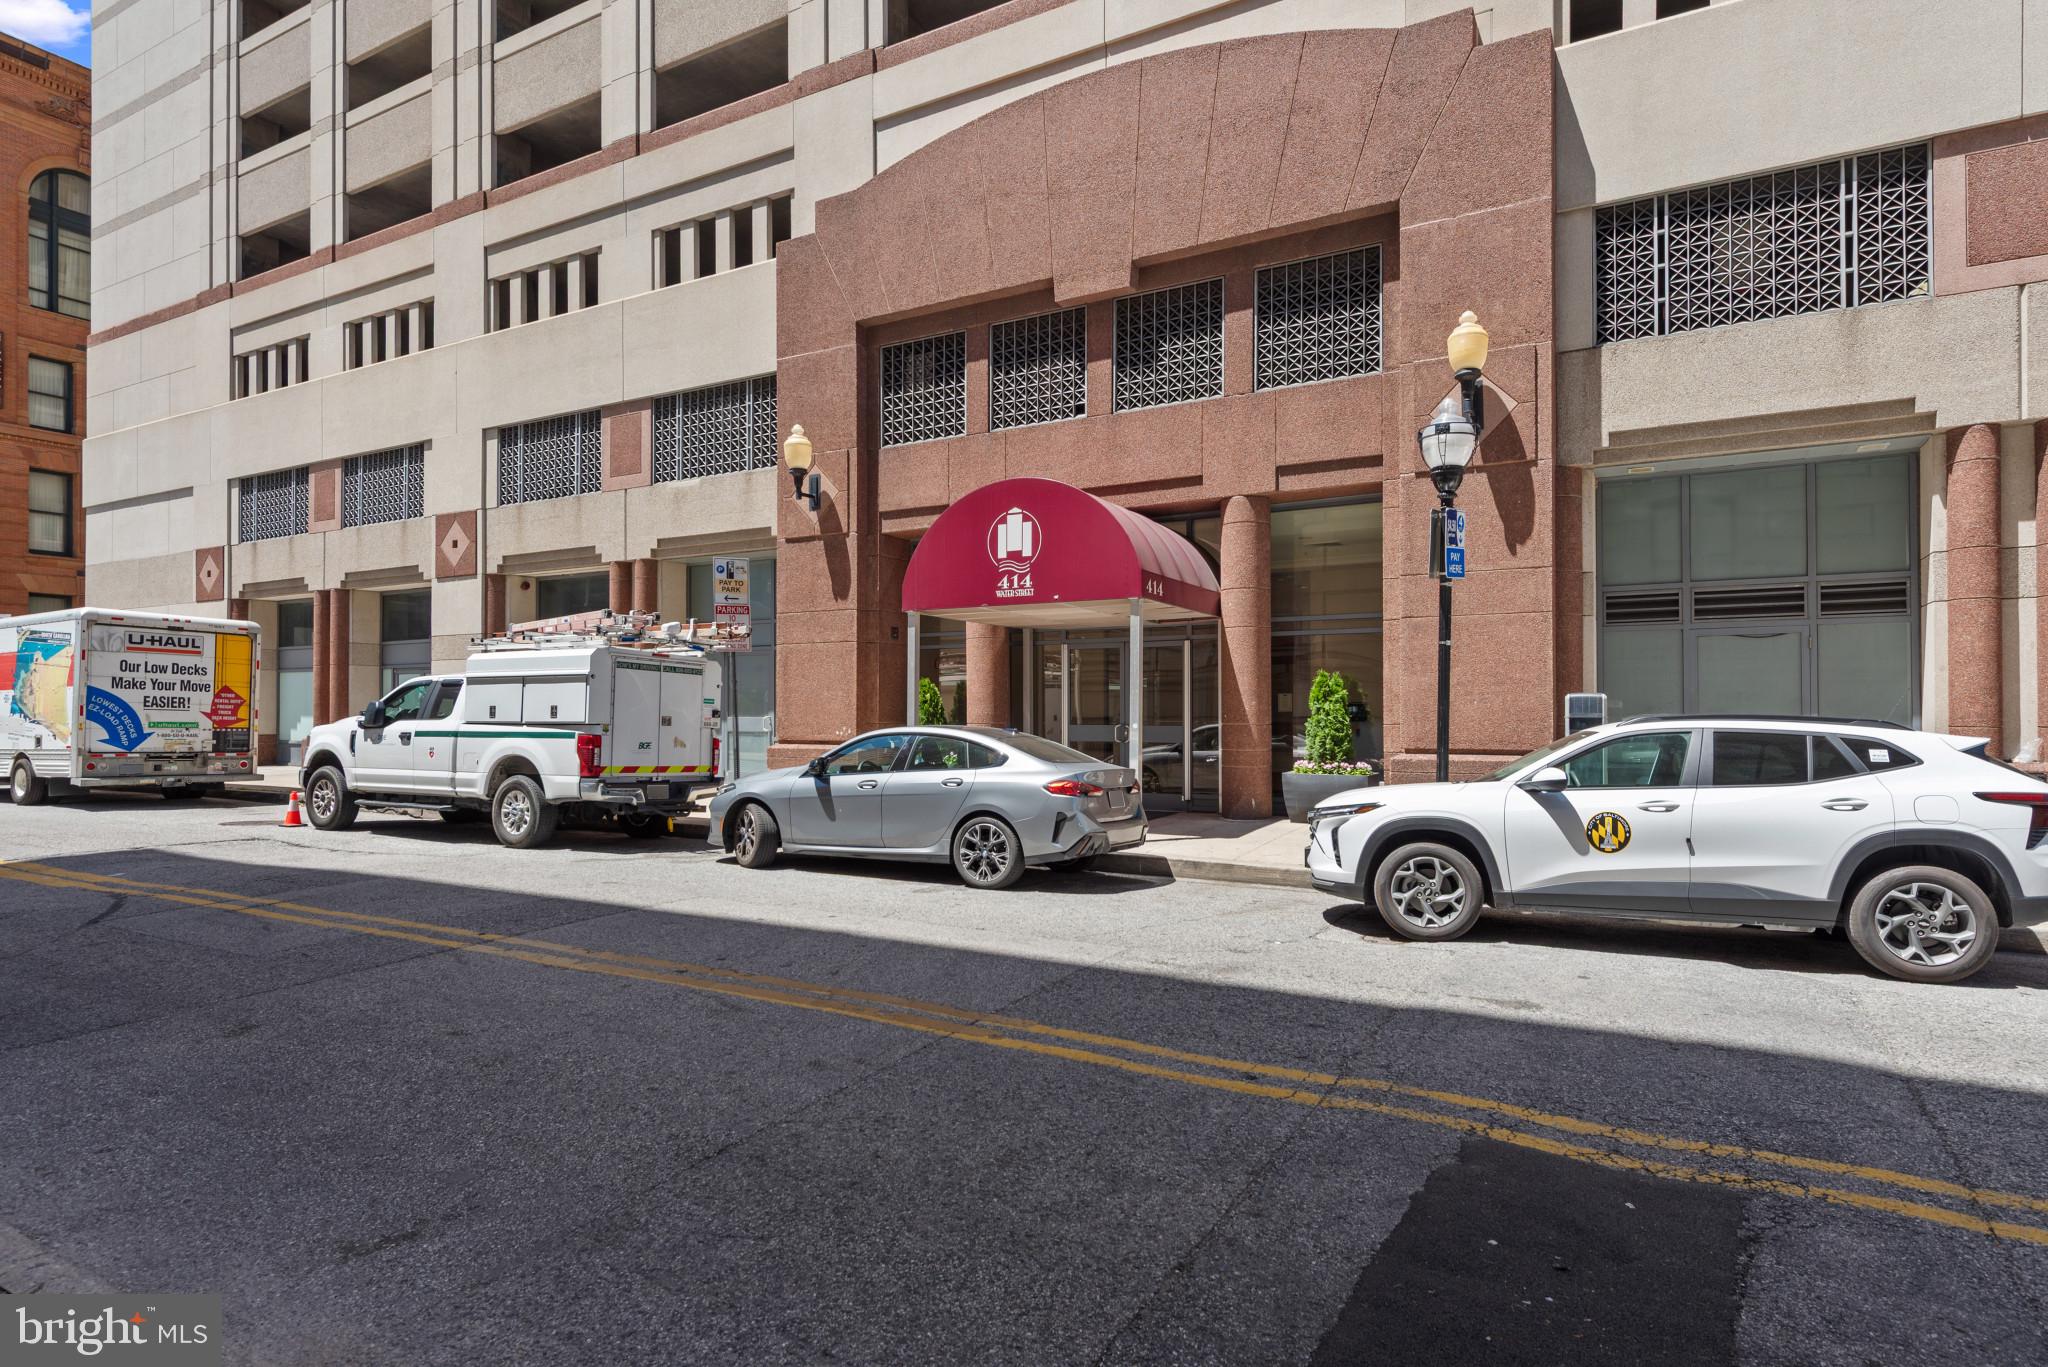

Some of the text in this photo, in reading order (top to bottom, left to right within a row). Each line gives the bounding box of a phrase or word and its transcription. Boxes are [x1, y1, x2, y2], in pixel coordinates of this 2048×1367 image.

[1450, 552, 1460, 561] PAY
[1449, 564, 1463, 574] HERE
[997, 573, 1033, 589] 414
[1146, 578, 1164, 597] 414
[995, 588, 1034, 598] WATER STREET
[717, 606, 748, 614] PARKING
[128, 633, 201, 649] U-HAUL
[120, 659, 208, 676] Our Low Decks
[111, 676, 211, 693] Make Your Move
[143, 695, 191, 709] EASIER!
[88, 703, 129, 746] EZ-LOAD RAMP
[91, 695, 138, 739] LOWEST DECKS
[638, 741, 653, 750] BGE
[1603, 813, 1630, 832] BALTIMORE
